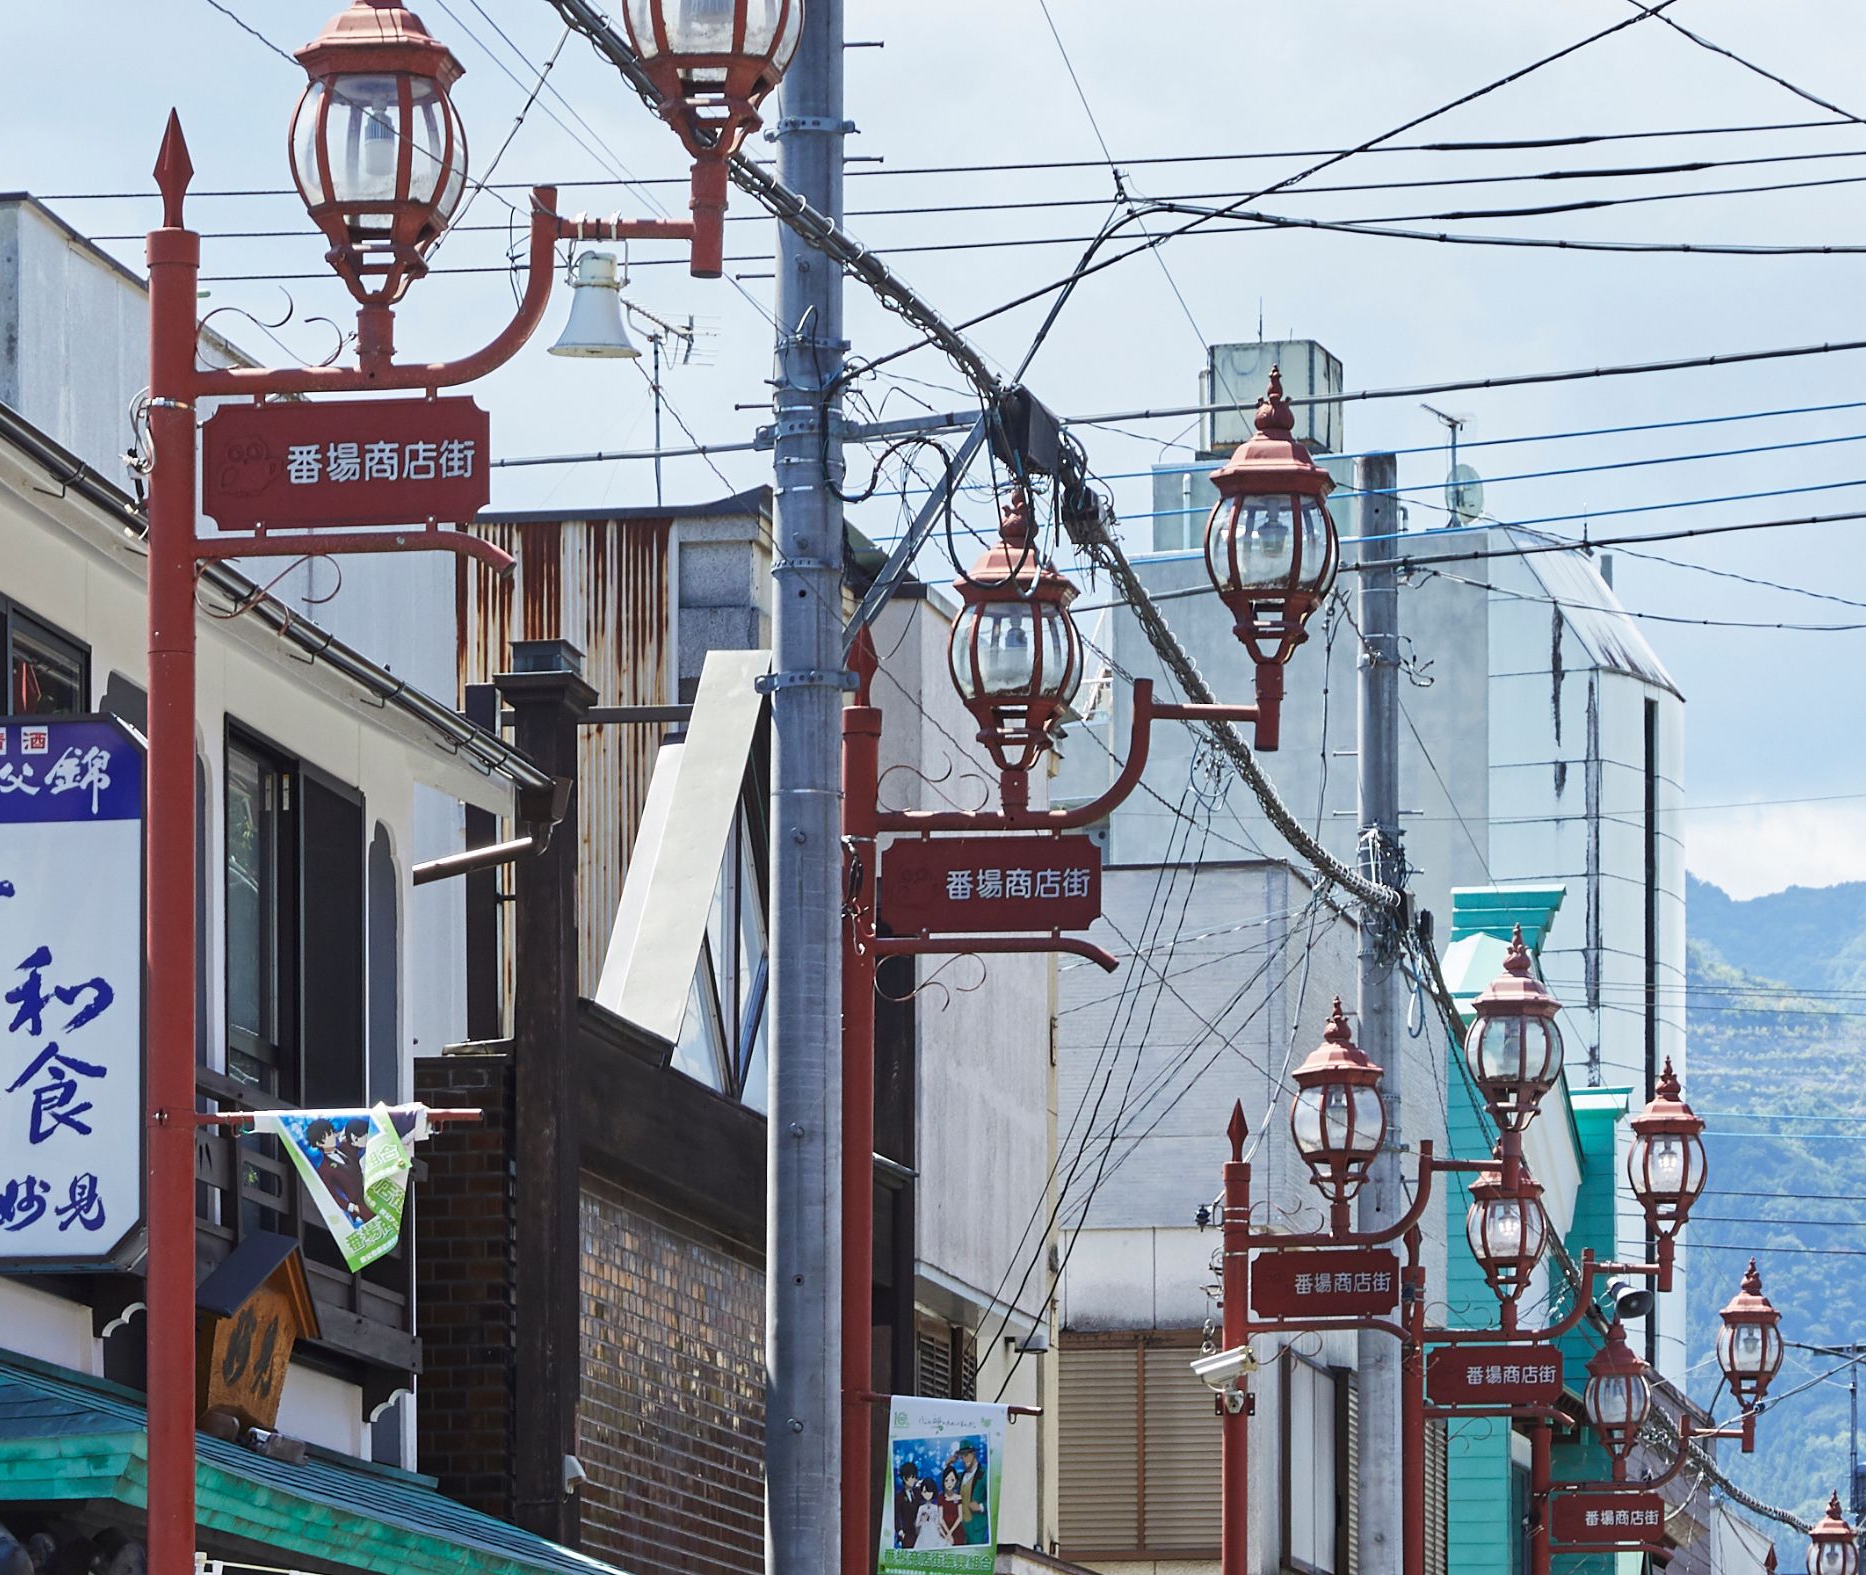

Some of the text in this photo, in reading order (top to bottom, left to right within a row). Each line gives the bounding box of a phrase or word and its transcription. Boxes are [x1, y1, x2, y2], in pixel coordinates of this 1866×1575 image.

[286, 438, 475, 487] 番場商店街
[945, 867, 1091, 900] 番場商店街
[5, 945, 115, 1145] 和食
[1294, 1270, 1392, 1296] 番場商店街
[1466, 1364, 1556, 1386] 番場商店街
[1584, 1507, 1660, 1527] 番場商店街
